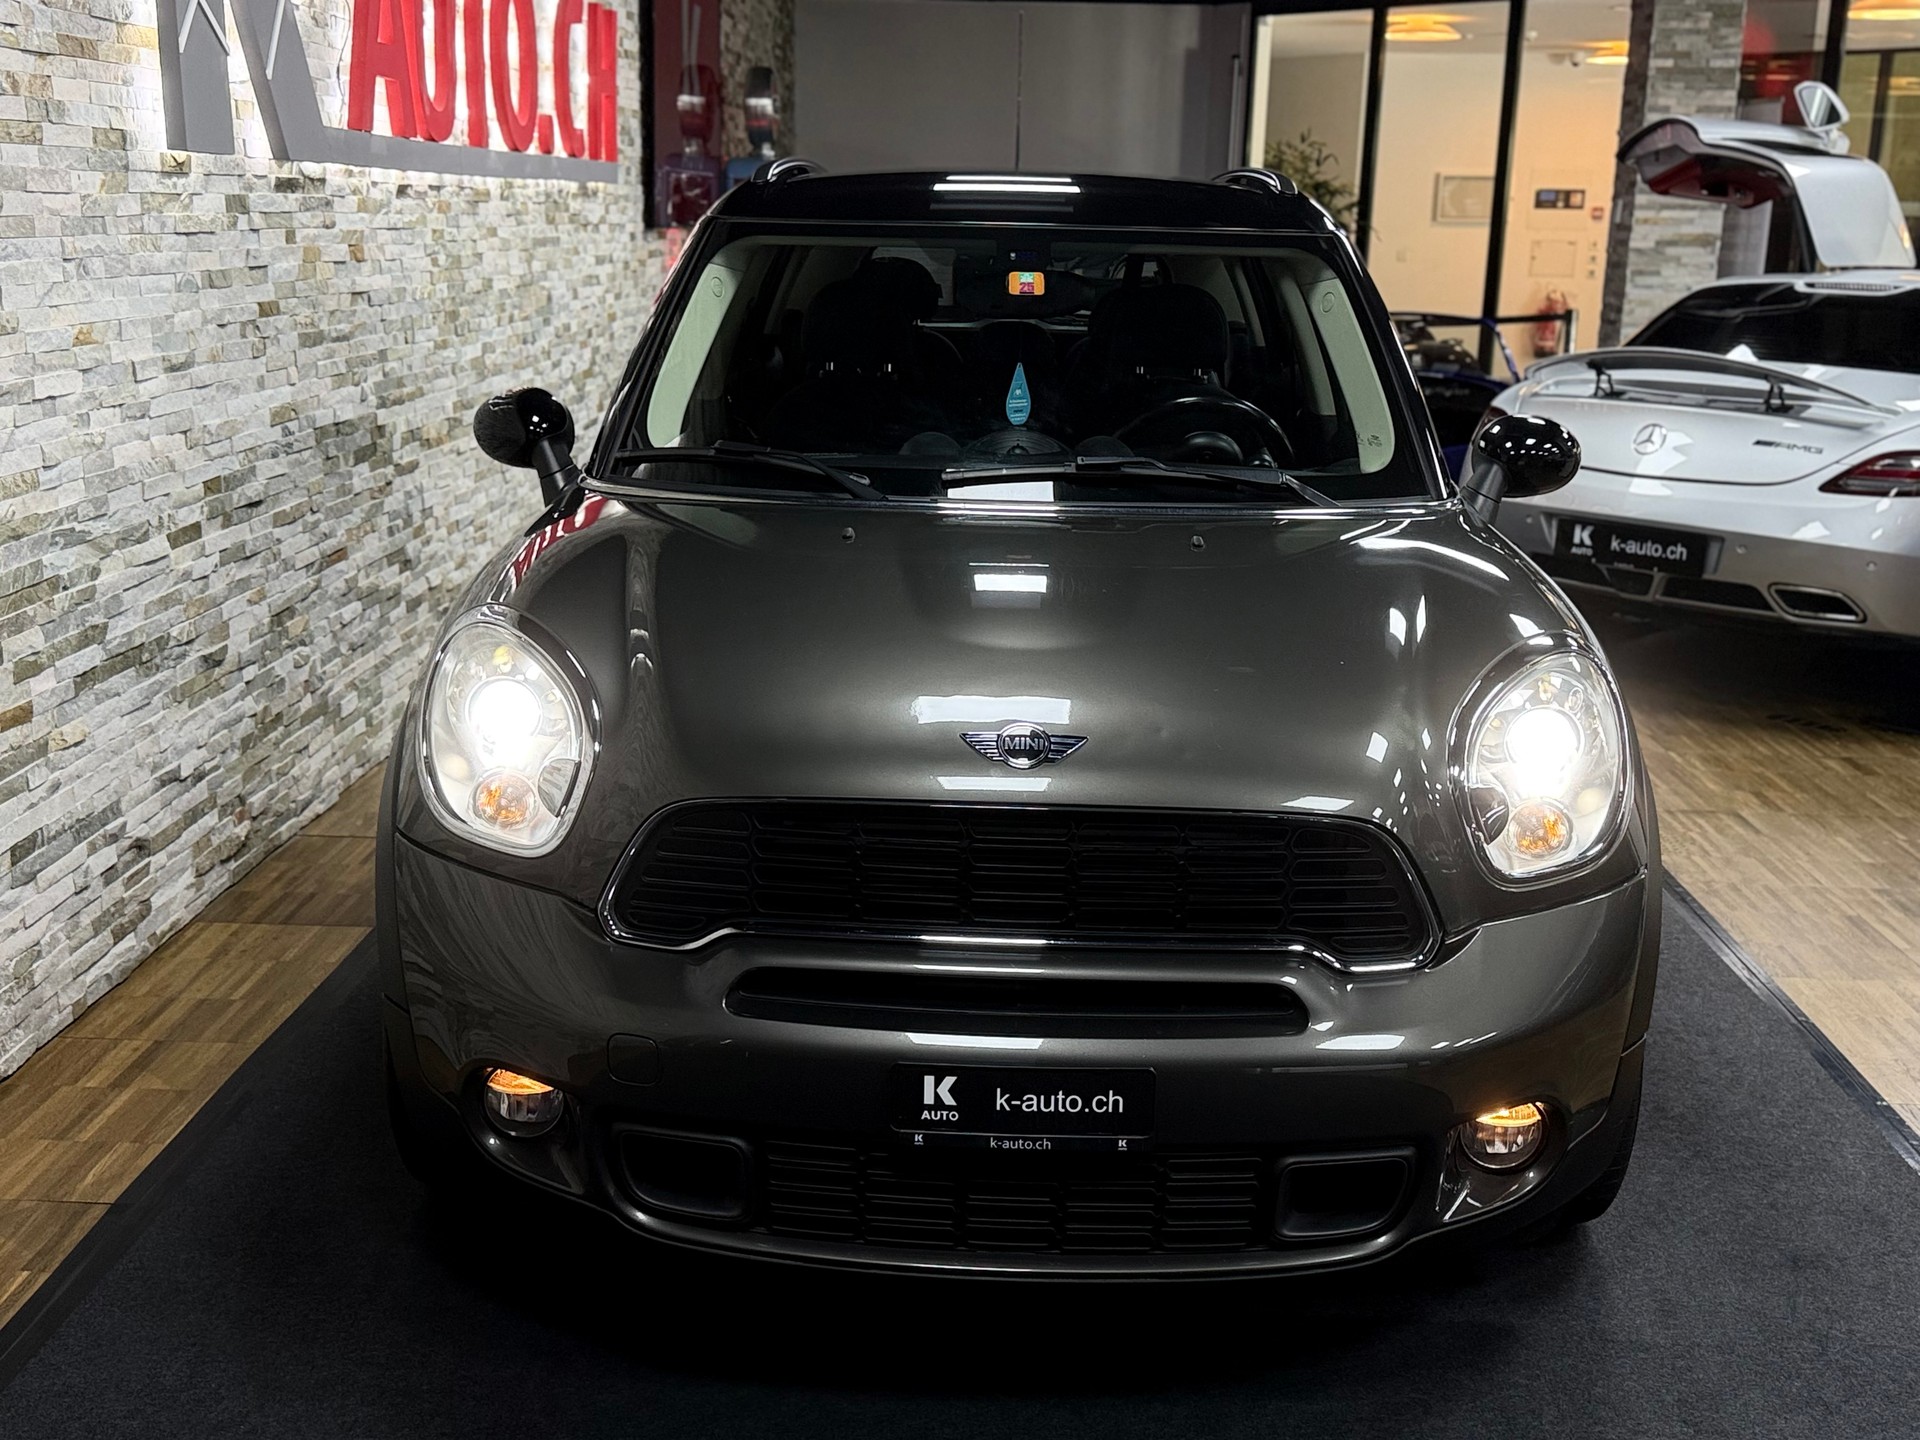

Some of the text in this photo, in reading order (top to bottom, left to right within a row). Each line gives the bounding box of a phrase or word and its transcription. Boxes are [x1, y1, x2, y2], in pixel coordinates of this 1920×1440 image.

[1573, 523, 1595, 547] K
[1610, 534, 1688, 561] k-auto.ch
[1004, 737, 1044, 751] MINI
[923, 1075, 958, 1106] K
[996, 1087, 1124, 1113] k-auto.ch
[921, 1110, 959, 1121] AUTO
[990, 1137, 1052, 1150] k-auto.ch
